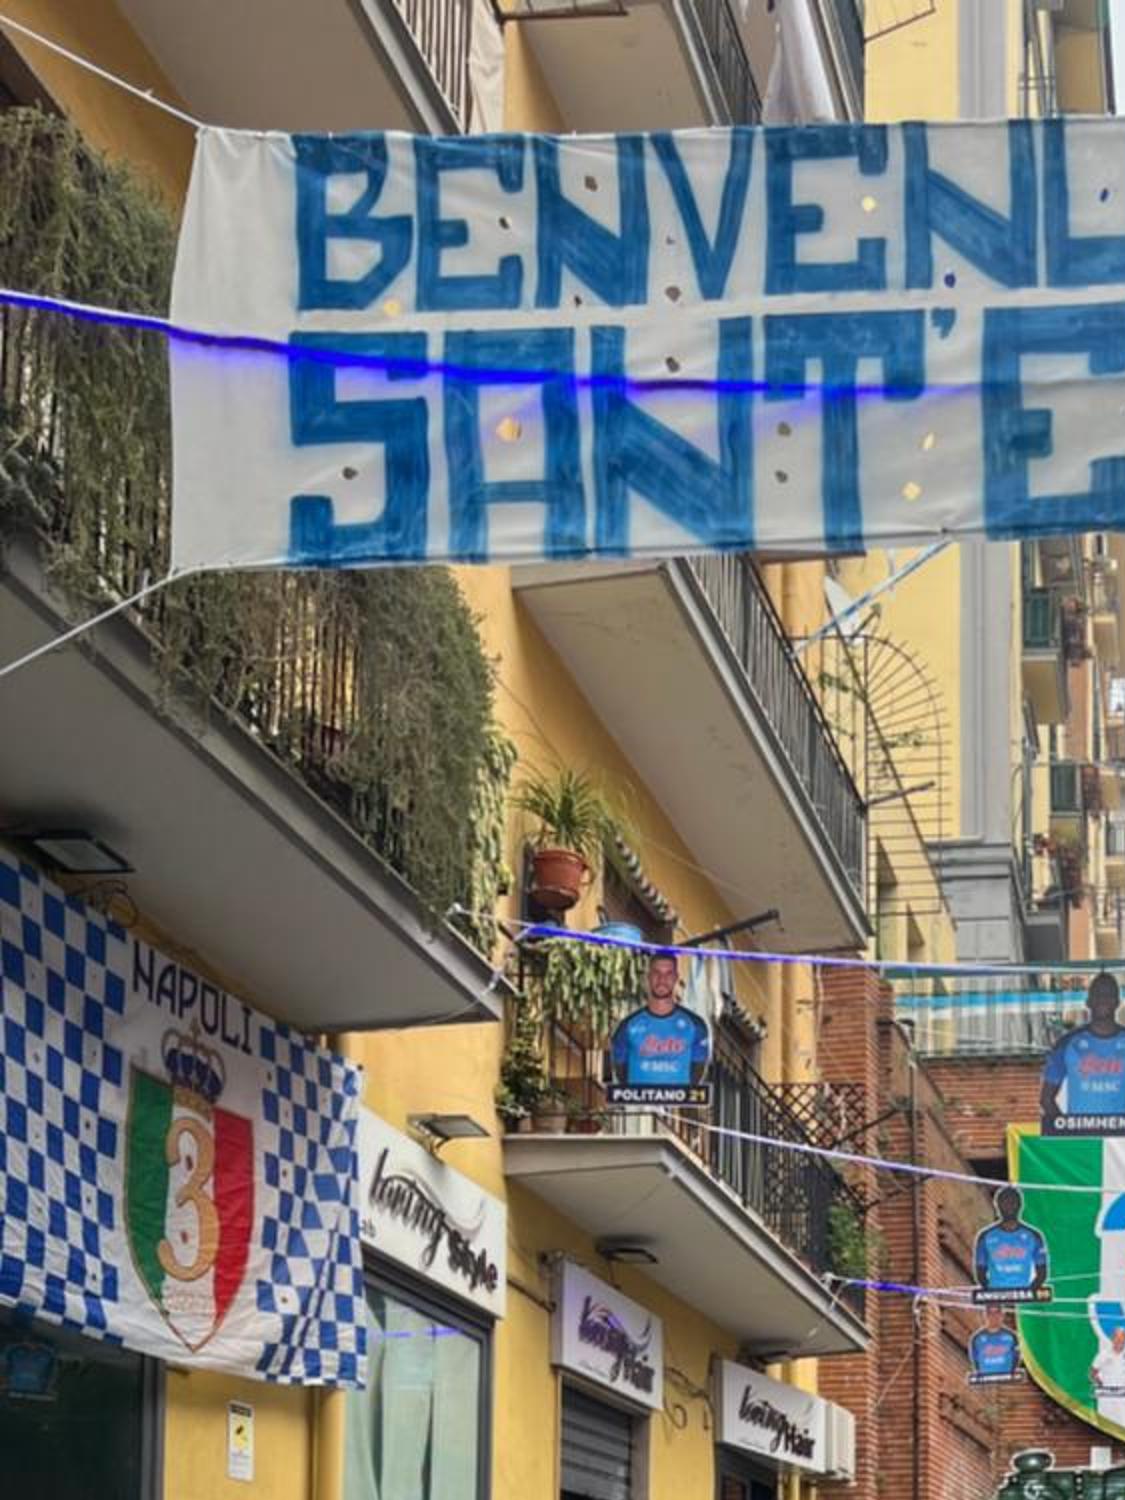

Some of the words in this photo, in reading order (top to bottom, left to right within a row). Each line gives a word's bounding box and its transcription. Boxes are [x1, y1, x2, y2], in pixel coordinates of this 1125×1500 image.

[131, 940, 254, 1055] NAPOLI
[613, 1088, 686, 1101] POLITANO
[156, 1116, 221, 1283] 3
